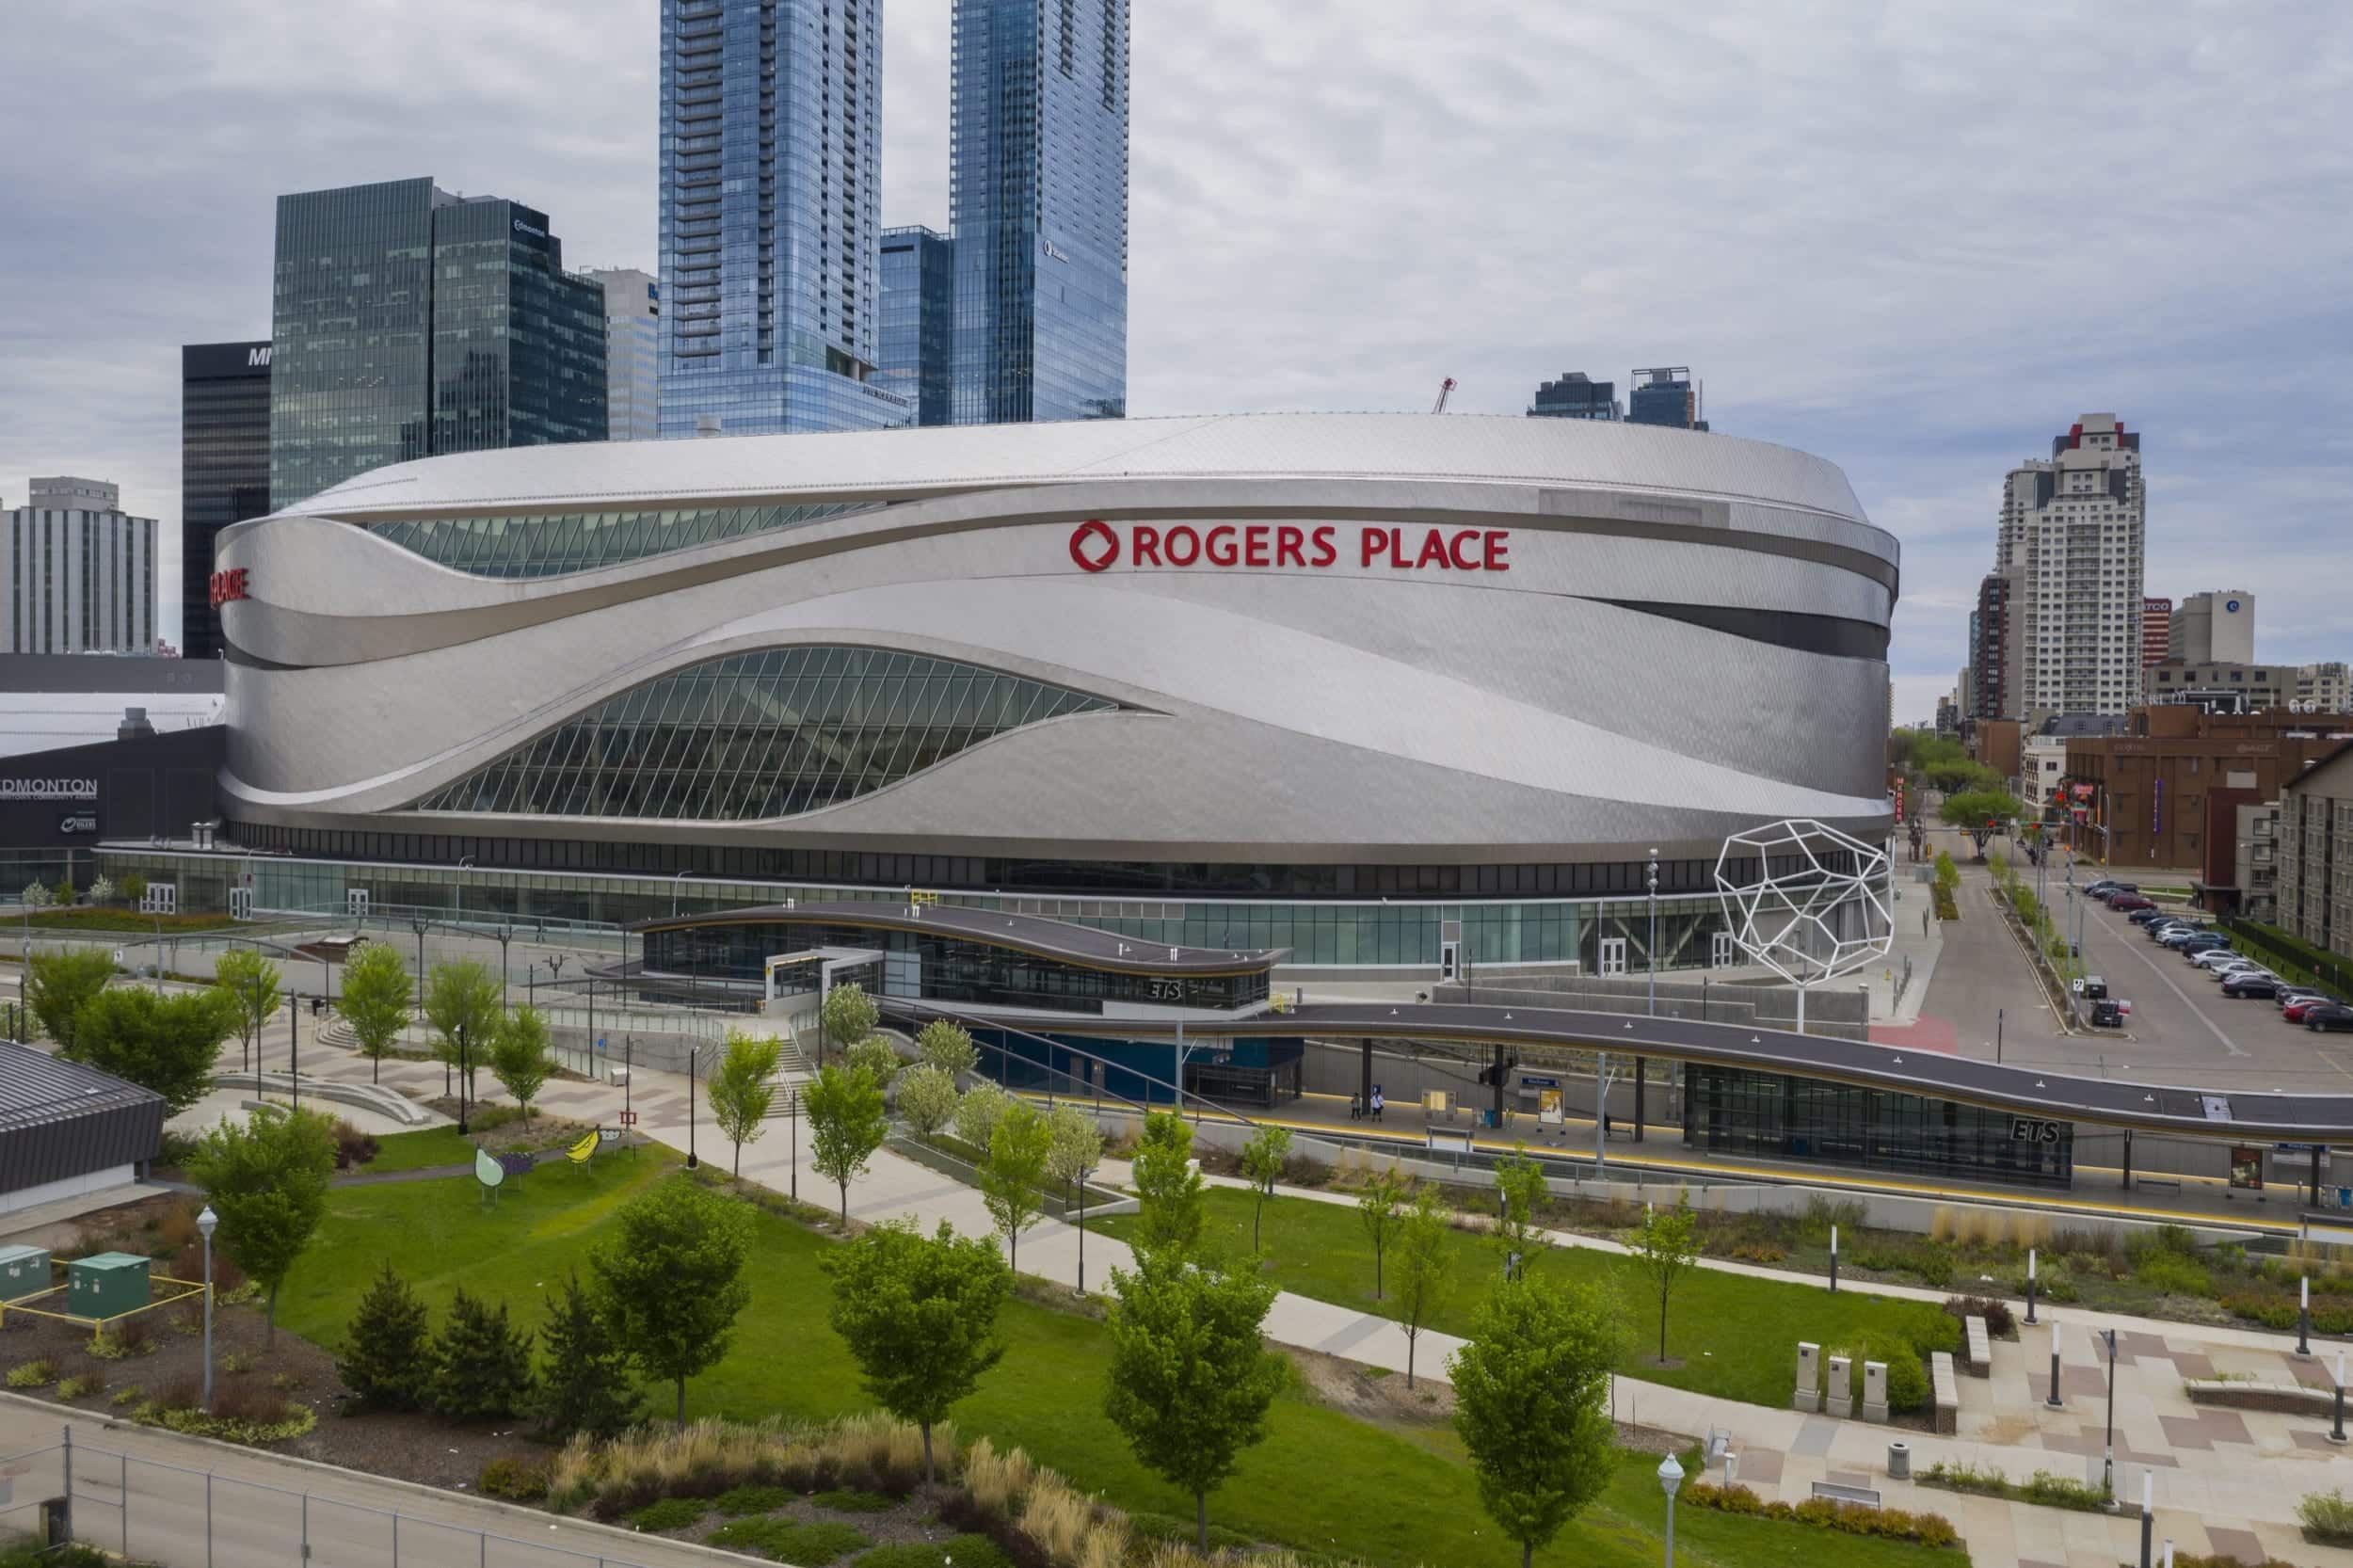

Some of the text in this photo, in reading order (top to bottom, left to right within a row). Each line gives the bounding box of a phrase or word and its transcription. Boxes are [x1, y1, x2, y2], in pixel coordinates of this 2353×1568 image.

[1132, 525, 1510, 570] ROGERS PLACE
[0, 778, 98, 793] DMONTON
[1148, 979, 1182, 1000] ETS
[2010, 1118, 2060, 1144] ETS
